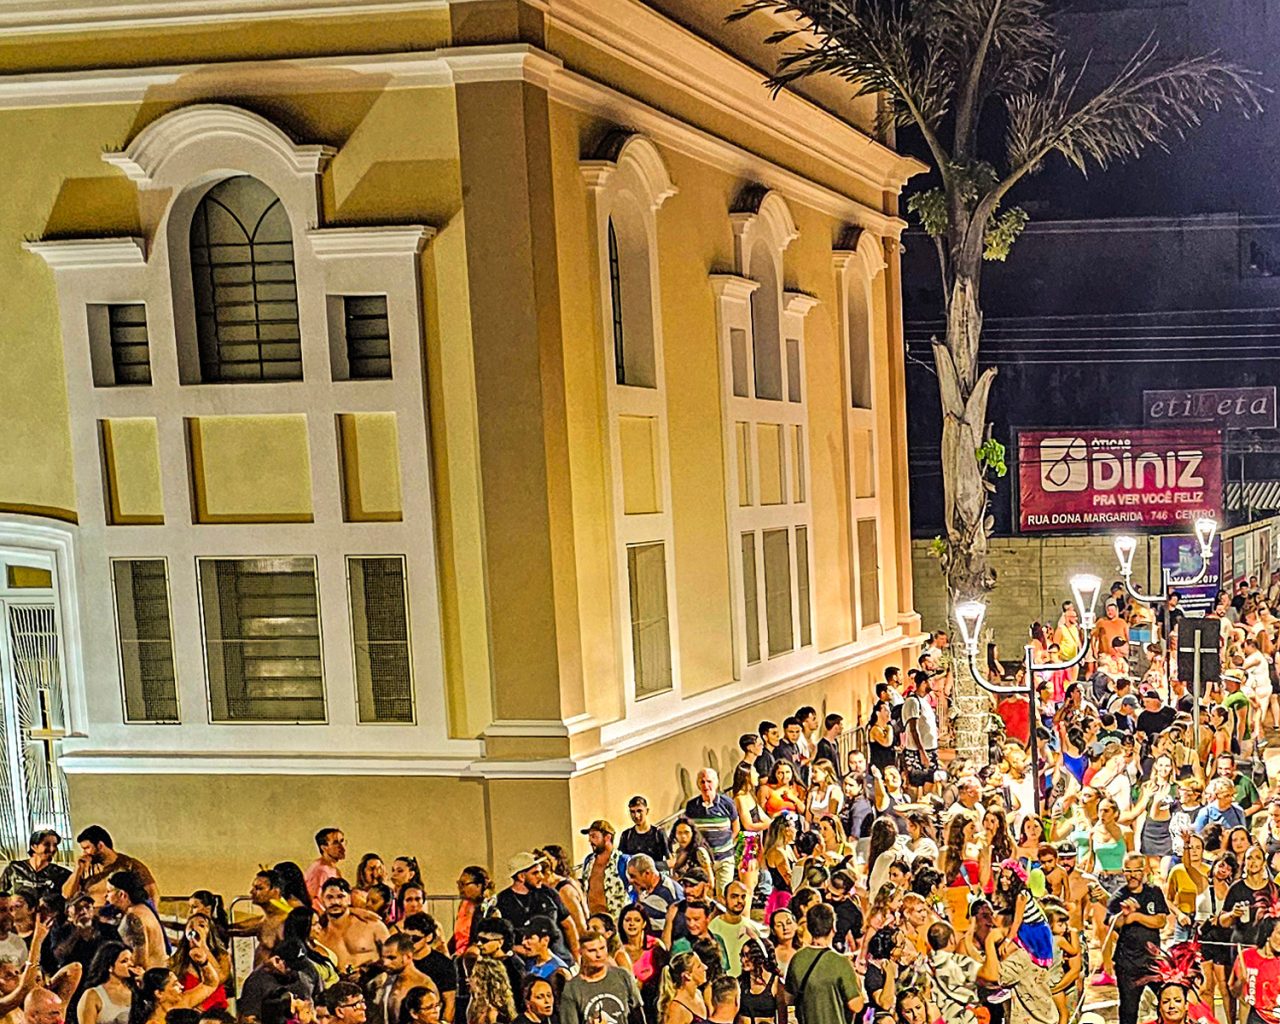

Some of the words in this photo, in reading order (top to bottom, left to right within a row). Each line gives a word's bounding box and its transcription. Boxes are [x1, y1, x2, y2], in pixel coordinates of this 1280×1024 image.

[1093, 494, 1116, 506] PRA
[1117, 493, 1141, 505] VER
[1142, 490, 1173, 505] VOCÊ
[1173, 491, 1203, 503] FELIZ
[1027, 514, 1050, 526] RUA
[1051, 513, 1081, 525] DONA
[1083, 510, 1143, 523] MARGARIDA
[1150, 510, 1168, 521] 746
